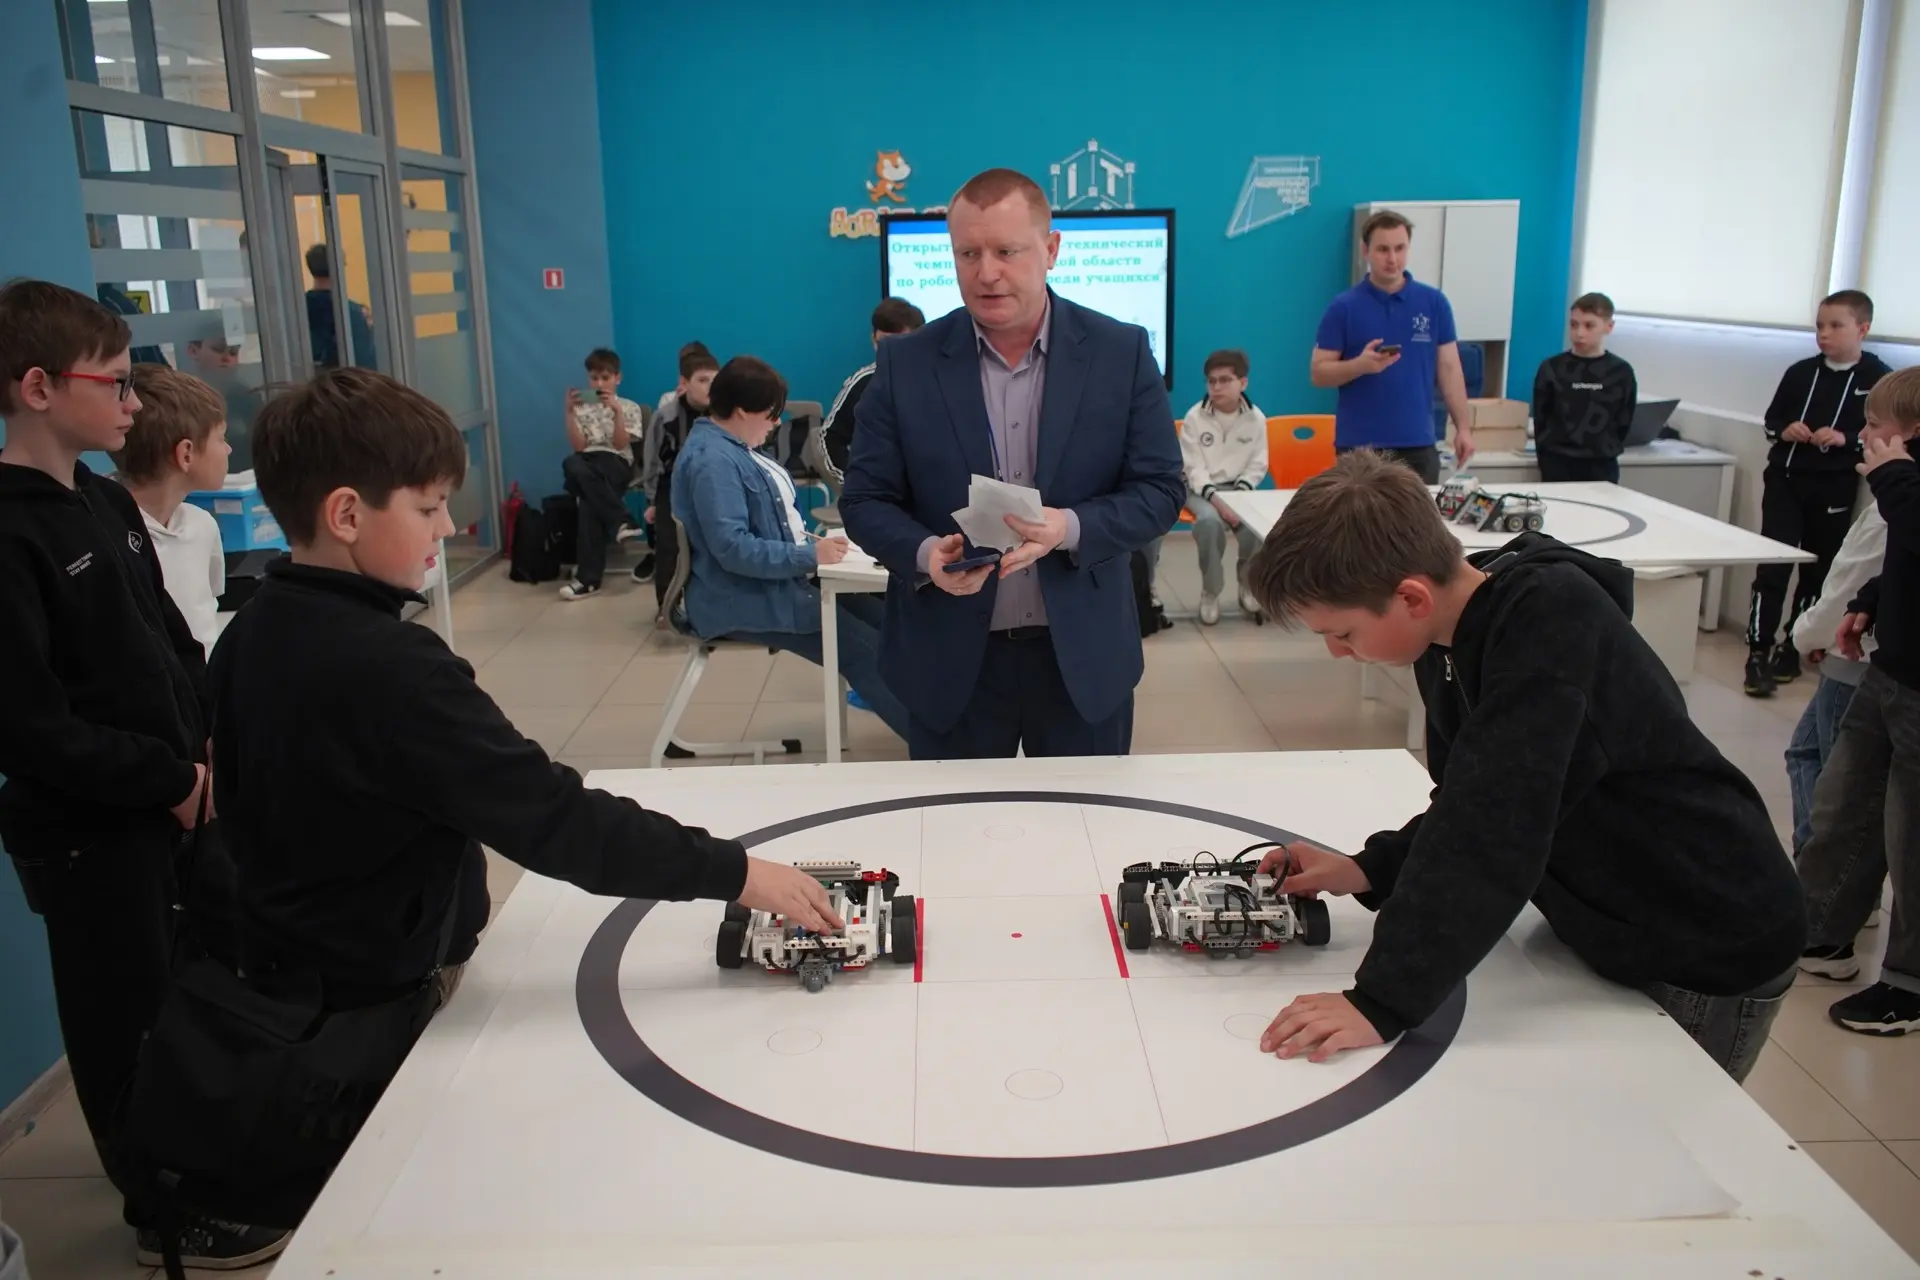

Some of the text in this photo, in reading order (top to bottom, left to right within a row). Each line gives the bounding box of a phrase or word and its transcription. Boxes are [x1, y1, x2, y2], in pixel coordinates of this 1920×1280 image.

[892, 242, 953, 256] Открыт
[1082, 255, 1142, 267] области
[896, 278, 914, 287] по
[1046, 274, 1080, 286] реди
[1086, 272, 1160, 286] учащихся
